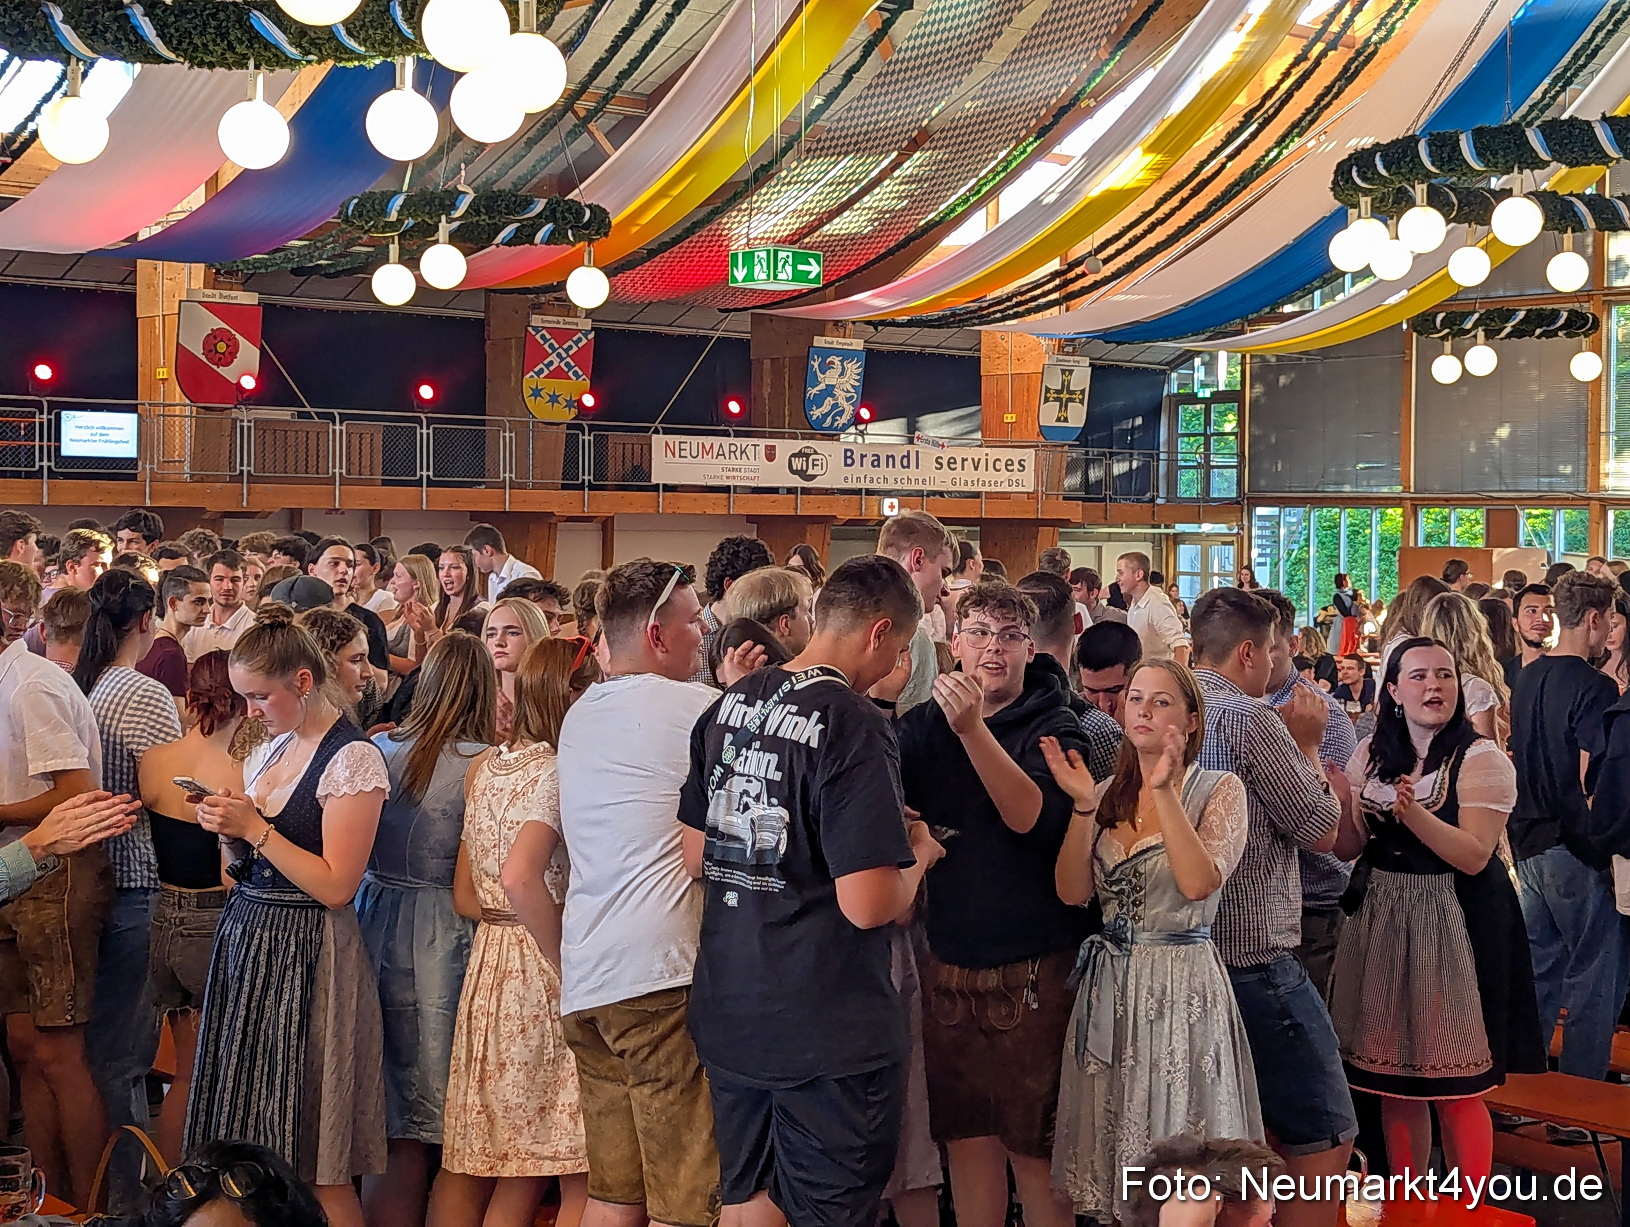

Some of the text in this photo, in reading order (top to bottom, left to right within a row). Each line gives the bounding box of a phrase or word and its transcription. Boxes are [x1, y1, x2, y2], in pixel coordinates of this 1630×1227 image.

[664, 440, 760, 461] NEUMARKT
[842, 448, 1027, 473] Brandl services
[702, 473, 760, 482] STARKE WIRTSCHAFT
[720, 466, 743, 474] STARKE
[843, 473, 889, 485] einfach
[893, 475, 936, 486] schnell
[950, 477, 1004, 488] Glasfaser
[1007, 478, 1027, 488] DSL
[763, 703, 827, 749] Wink
